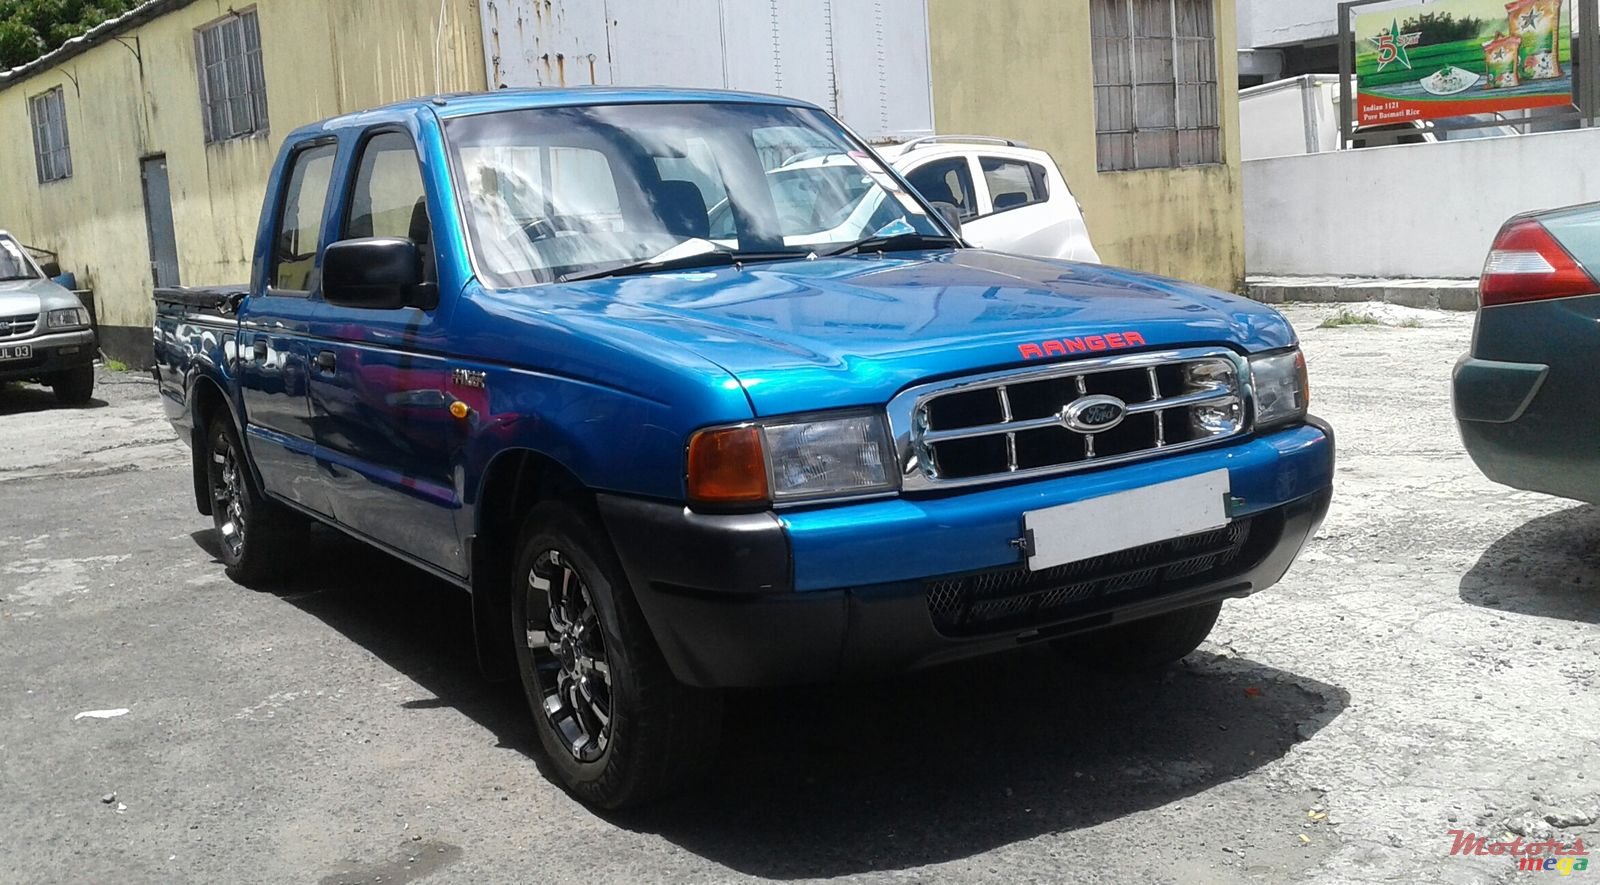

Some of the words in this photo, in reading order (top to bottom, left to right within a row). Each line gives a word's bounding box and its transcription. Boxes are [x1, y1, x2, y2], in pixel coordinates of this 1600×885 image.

[1377, 35, 1398, 64] 5
[1363, 103, 1383, 112] Indian
[1384, 101, 1399, 109] 1121
[1363, 113, 1378, 121] Pure
[1405, 108, 1420, 116] Rice
[14, 346, 29, 357] 03
[1017, 331, 1146, 359] RANGER
[1084, 405, 1116, 424] Ford
